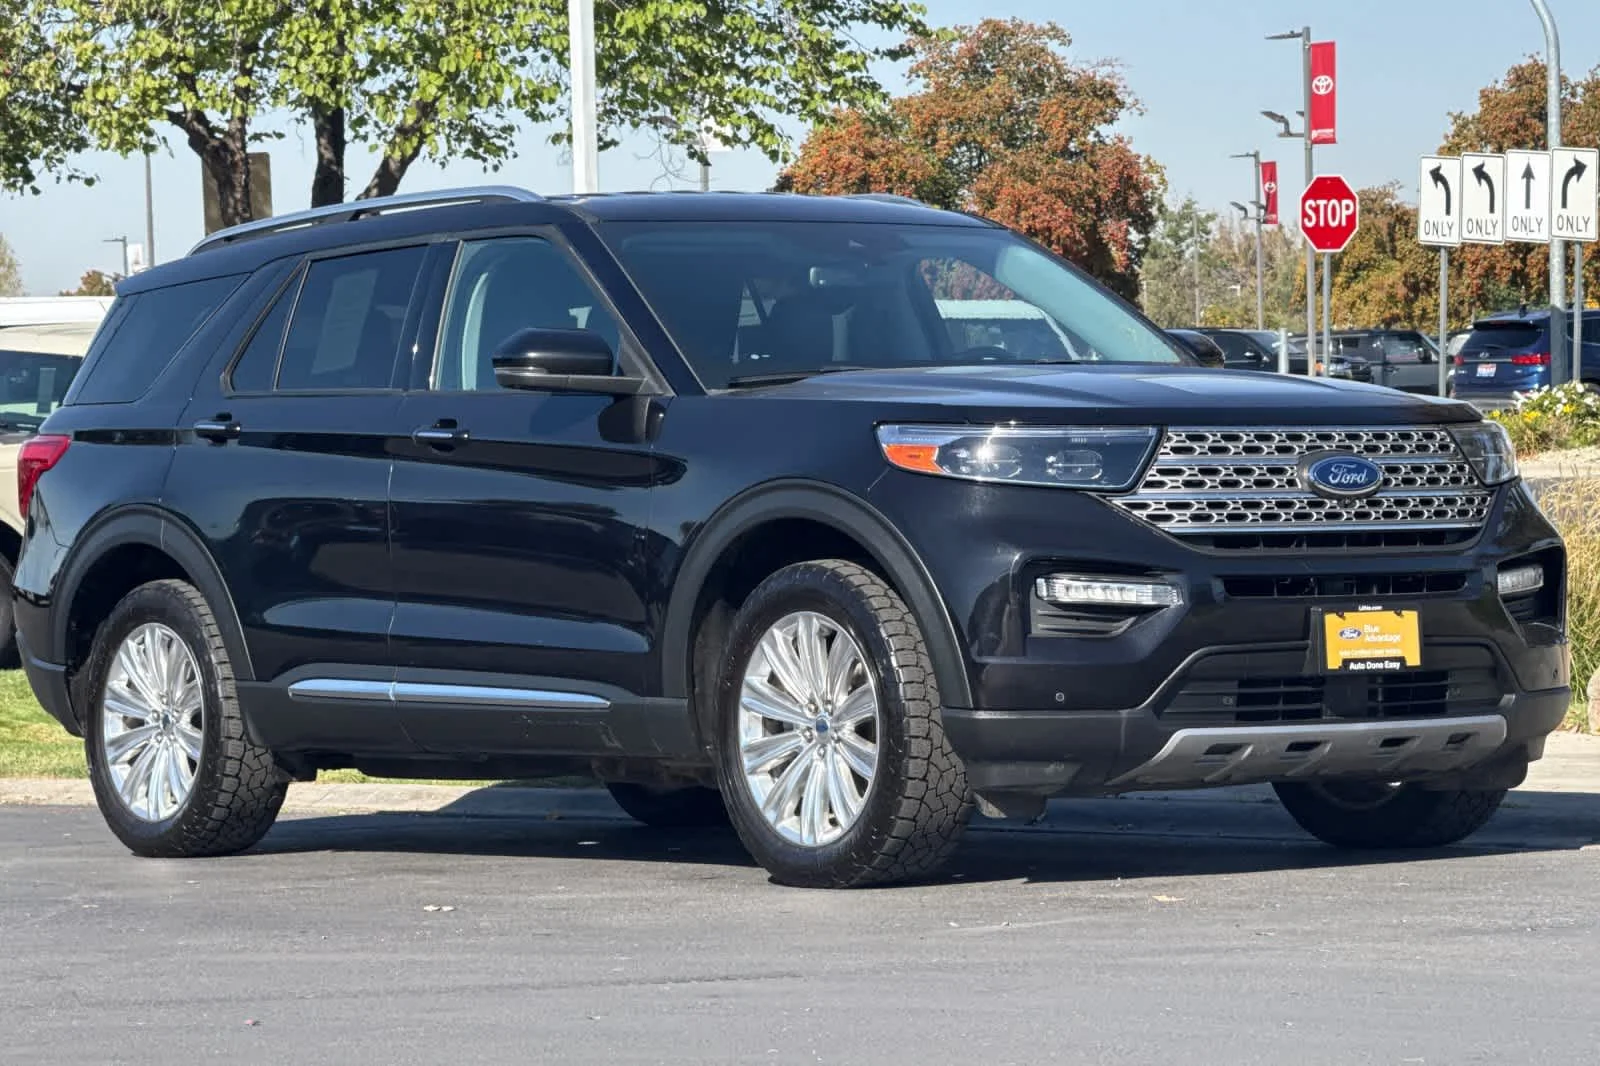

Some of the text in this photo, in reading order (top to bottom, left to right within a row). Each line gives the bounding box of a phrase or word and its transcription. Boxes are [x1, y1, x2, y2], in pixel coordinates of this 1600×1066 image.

[1304, 199, 1354, 228] STOP
[1424, 219, 1454, 237] ONLY
[1466, 217, 1498, 236] ONLY
[1511, 215, 1543, 233] ONLY
[1556, 214, 1590, 233] ONLY
[1328, 463, 1368, 484] Ford
[1349, 660, 1401, 671] Auto Done Easy
